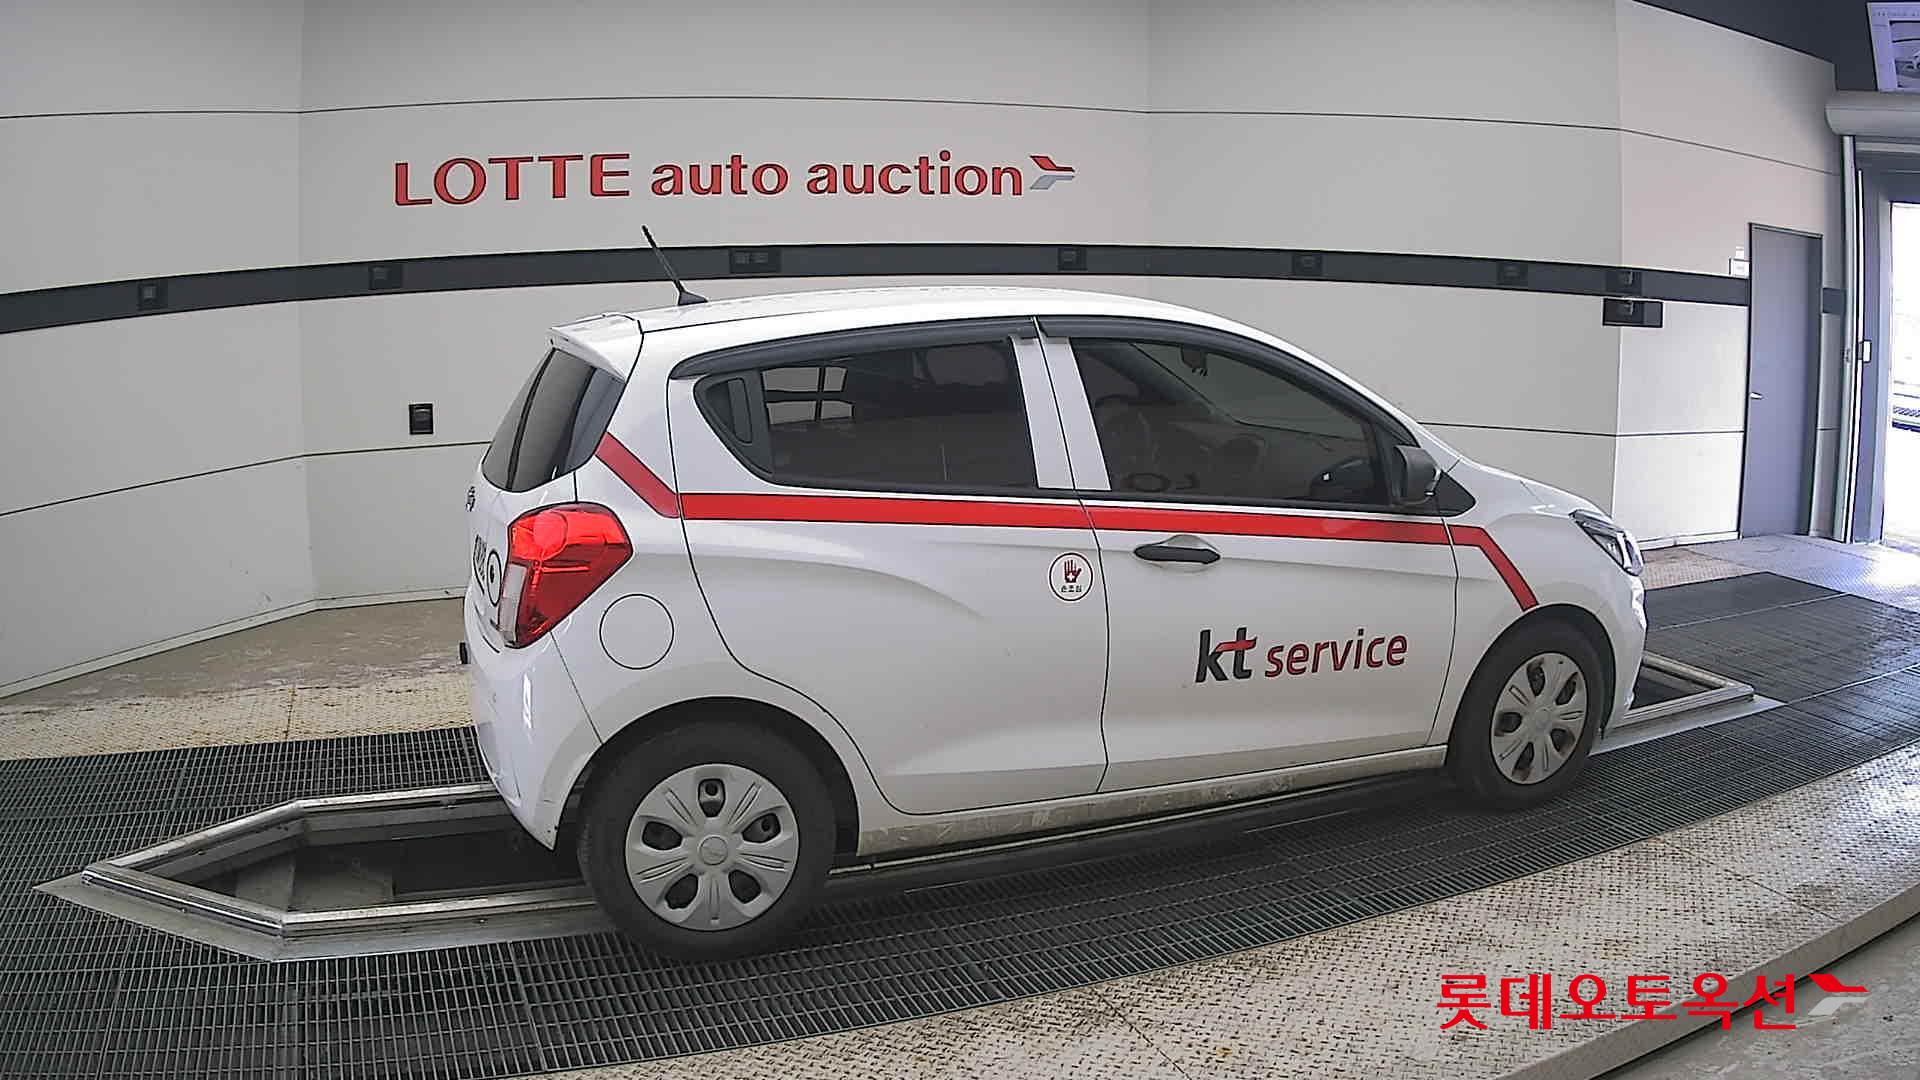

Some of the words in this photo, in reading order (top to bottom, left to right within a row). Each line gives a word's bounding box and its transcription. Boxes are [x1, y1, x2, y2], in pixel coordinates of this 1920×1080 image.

[394, 153, 630, 206] LOTTE
[650, 155, 789, 197] auto
[806, 150, 1023, 197] auction
[1195, 627, 1257, 683] kt
[1264, 628, 1408, 678] service
